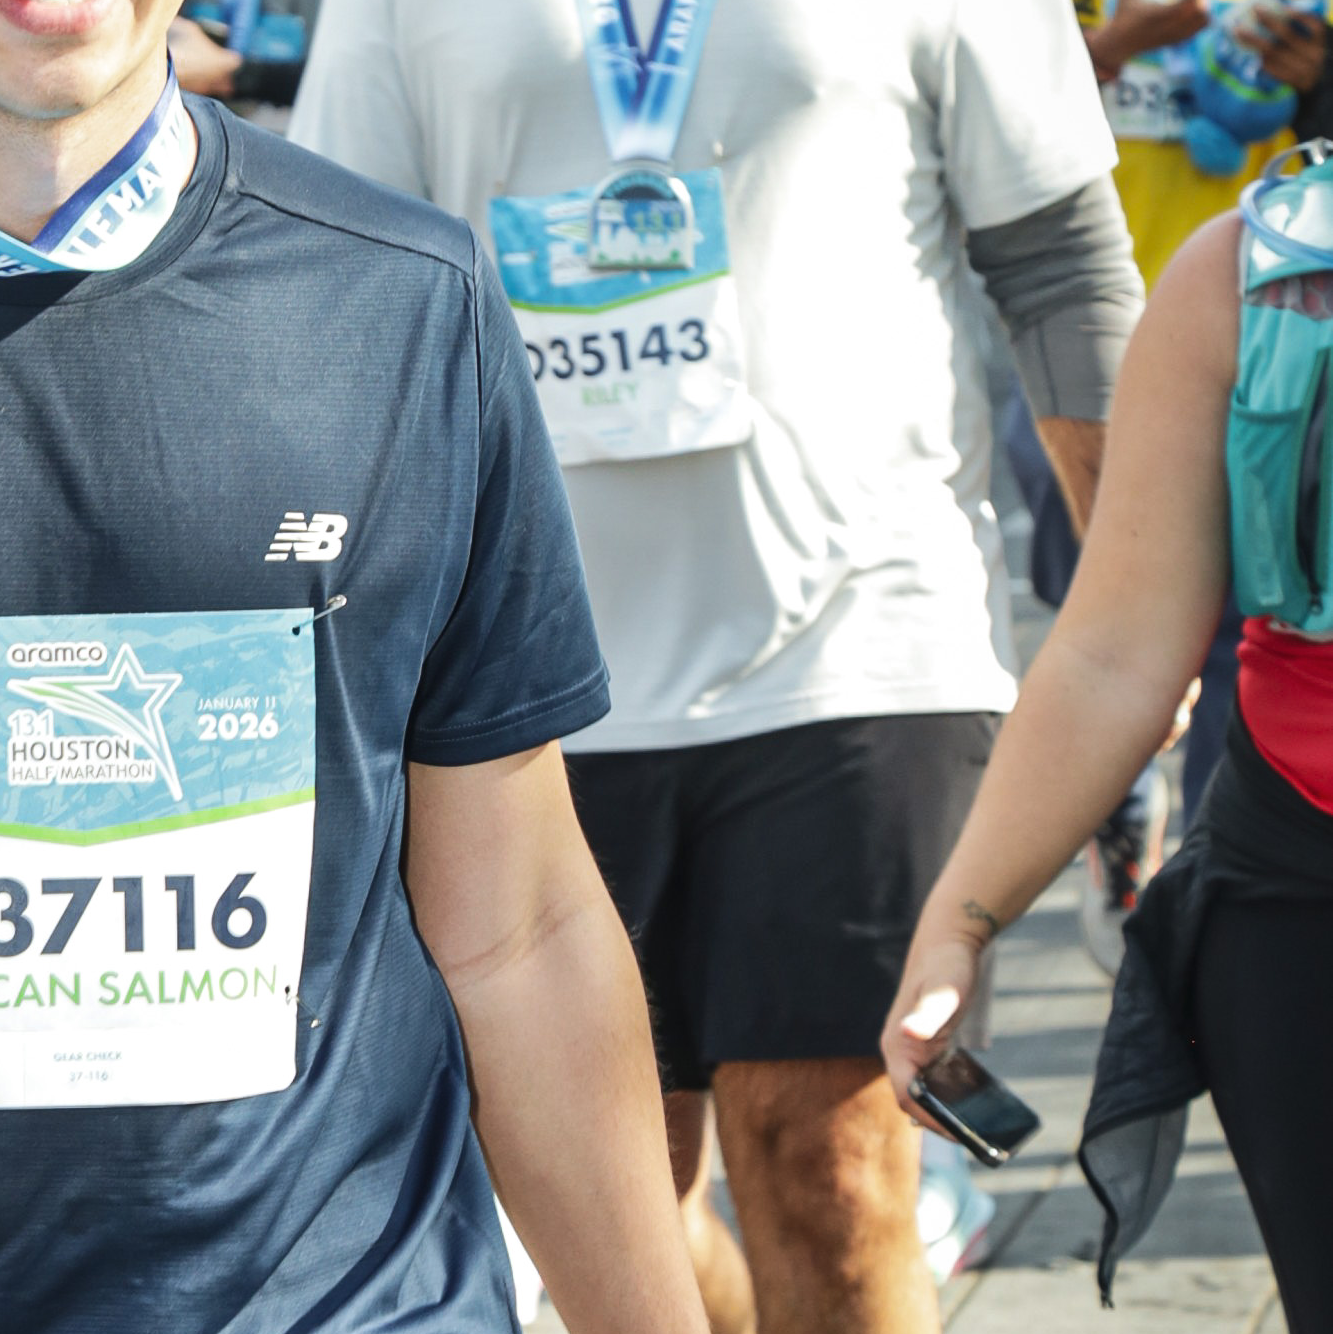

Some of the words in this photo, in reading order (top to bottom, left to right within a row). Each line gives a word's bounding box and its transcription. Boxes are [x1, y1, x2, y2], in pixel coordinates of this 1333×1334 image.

[12, 647, 103, 662] aramco
[198, 696, 259, 711] JANUARY
[12, 713, 50, 736] 13.1
[198, 712, 278, 741] 2026
[12, 739, 130, 761] HOUSTON
[12, 766, 53, 780] HALF
[60, 763, 152, 779] MARATHON
[99, 964, 278, 1005] SALMON
[87, 1051, 122, 1061] CHECK
